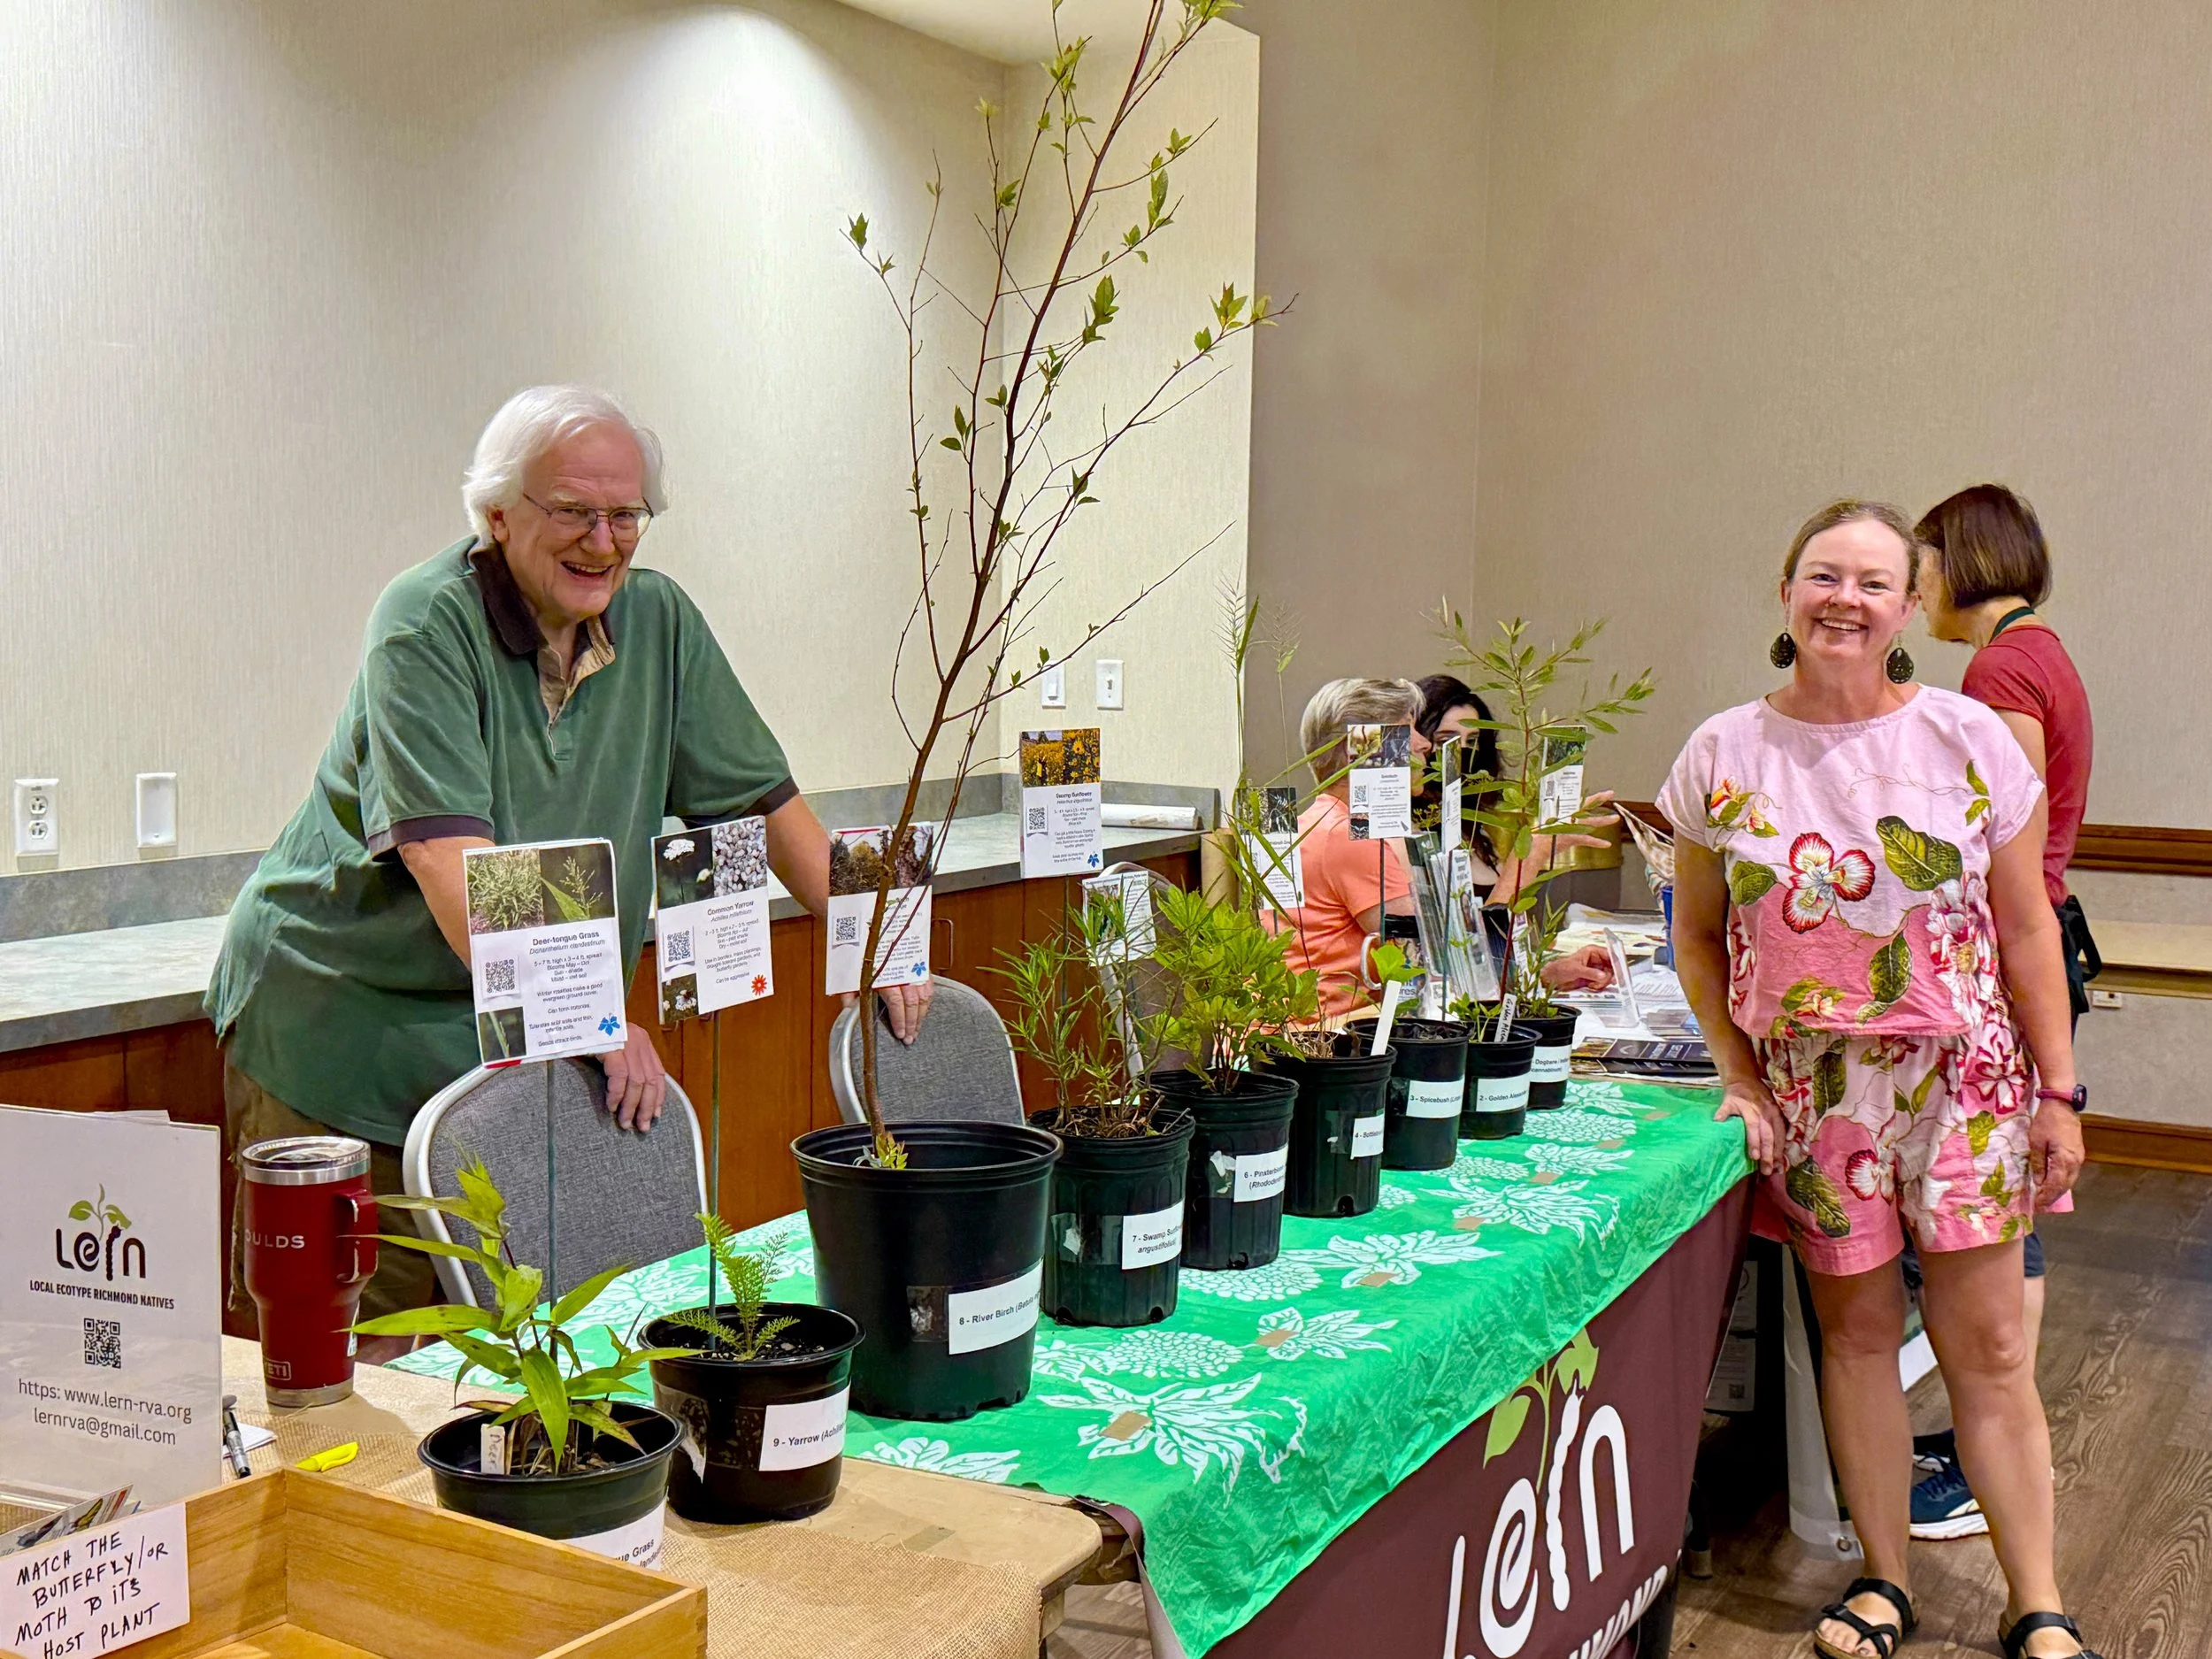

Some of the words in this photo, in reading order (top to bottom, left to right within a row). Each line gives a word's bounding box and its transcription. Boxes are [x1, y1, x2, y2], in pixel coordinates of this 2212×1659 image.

[708, 905, 733, 915] Common
[533, 934, 577, 946] Deer-tongue
[579, 931, 599, 940] Grass
[29, 1279, 55, 1294] LOCAL
[56, 1285, 92, 1299] ECOTYPE
[93, 1289, 139, 1304] RICHMOND
[140, 1295, 175, 1310] NATIVES
[972, 1313, 994, 1324] River
[995, 1307, 1014, 1318] Birch
[19, 1379, 61, 1400] https:
[65, 1388, 192, 1424] www.lern-rva.org
[34, 1407, 176, 1446] lernrva@gmail.com
[773, 1438, 780, 1447] 9
[788, 1434, 819, 1446] Yarrow
[16, 1549, 72, 1586] MATCH
[86, 1531, 122, 1559] THE
[633, 1539, 654, 1557] Grass
[15, 1607, 67, 1646] MOTH
[43, 1632, 84, 1659] HOST
[101, 1602, 160, 1649] PLANT
